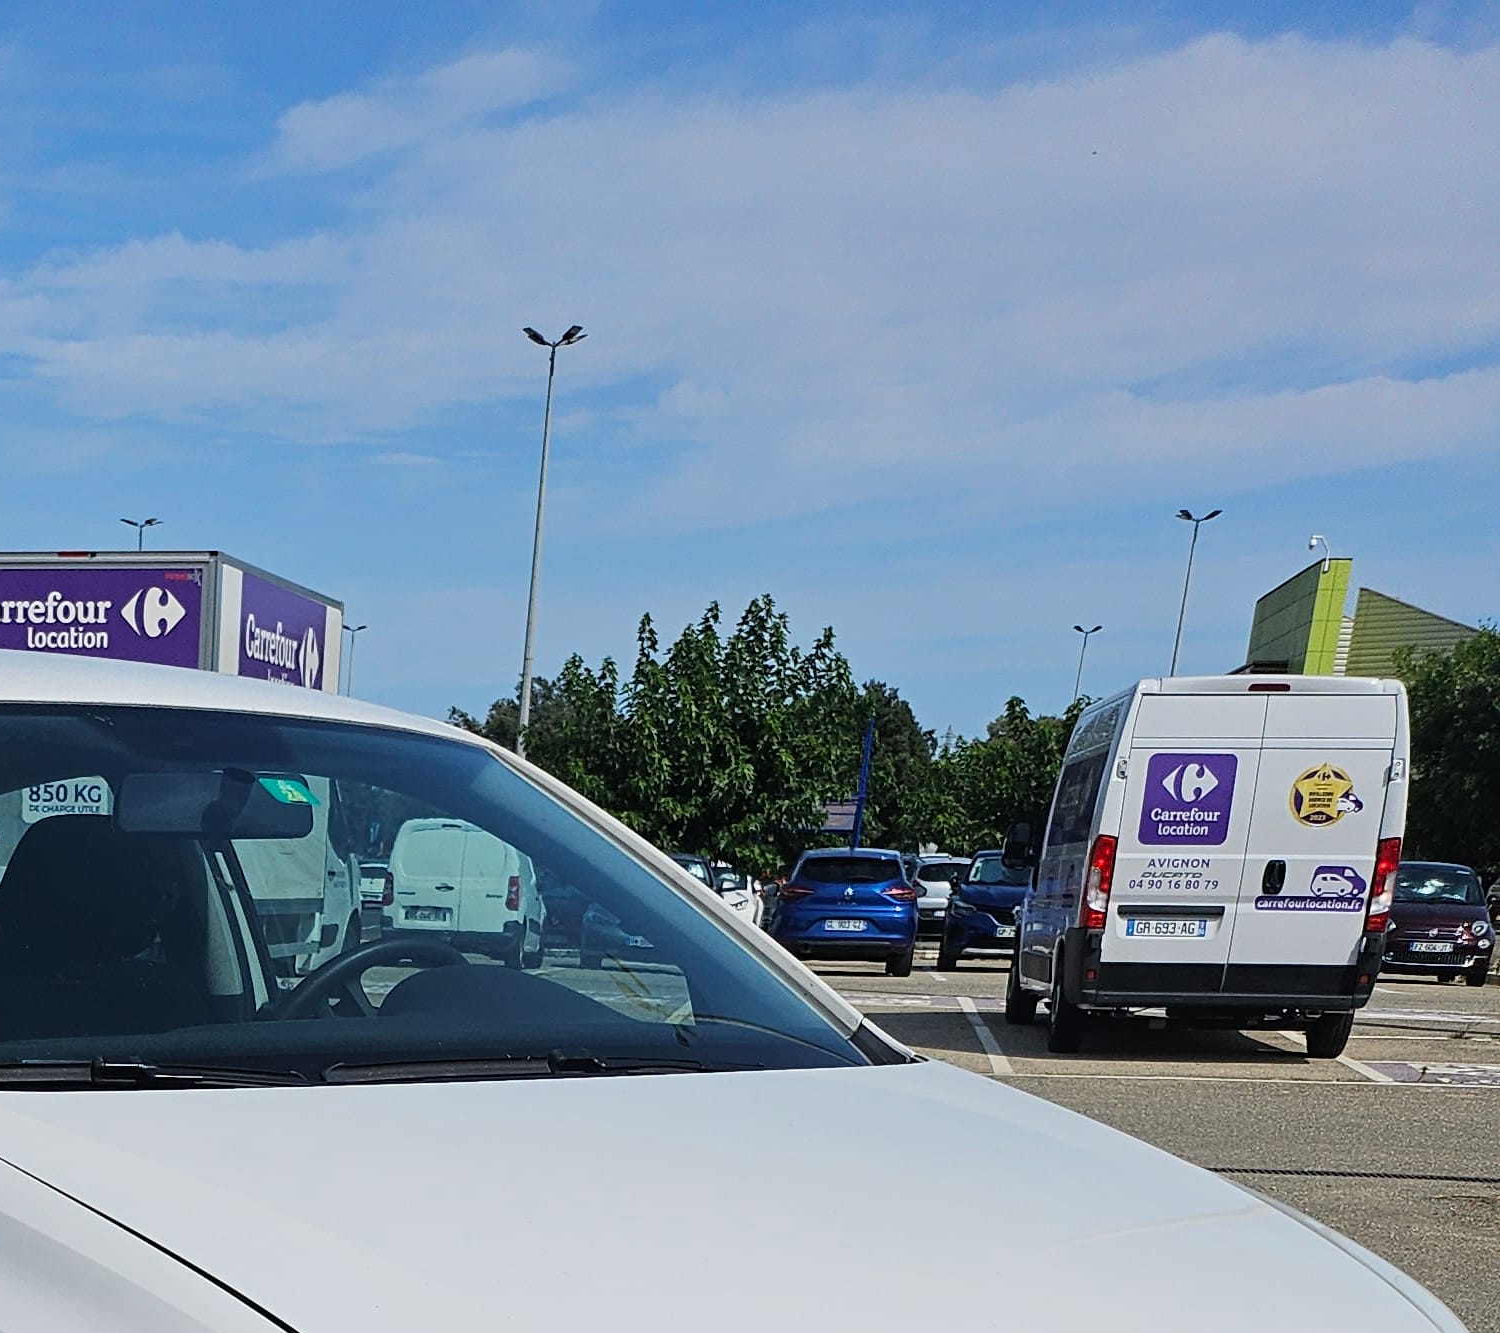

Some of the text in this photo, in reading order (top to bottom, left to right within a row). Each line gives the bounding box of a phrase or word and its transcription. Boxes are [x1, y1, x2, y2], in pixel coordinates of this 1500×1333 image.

[27, 627, 108, 649] location
[245, 613, 298, 670] Carrefour
[28, 783, 102, 803] 850 KG
[41, 805, 76, 813] CHARGE
[77, 805, 101, 813] UTILE
[1150, 807, 1221, 822] Carrefour
[1157, 822, 1209, 836] location
[1146, 858, 1211, 869] AVIGNON
[1140, 871, 1203, 879] DUCATO
[1128, 879, 1219, 890] 04 90 16 80 79
[1256, 898, 1362, 910] carrefourlocation.fr
